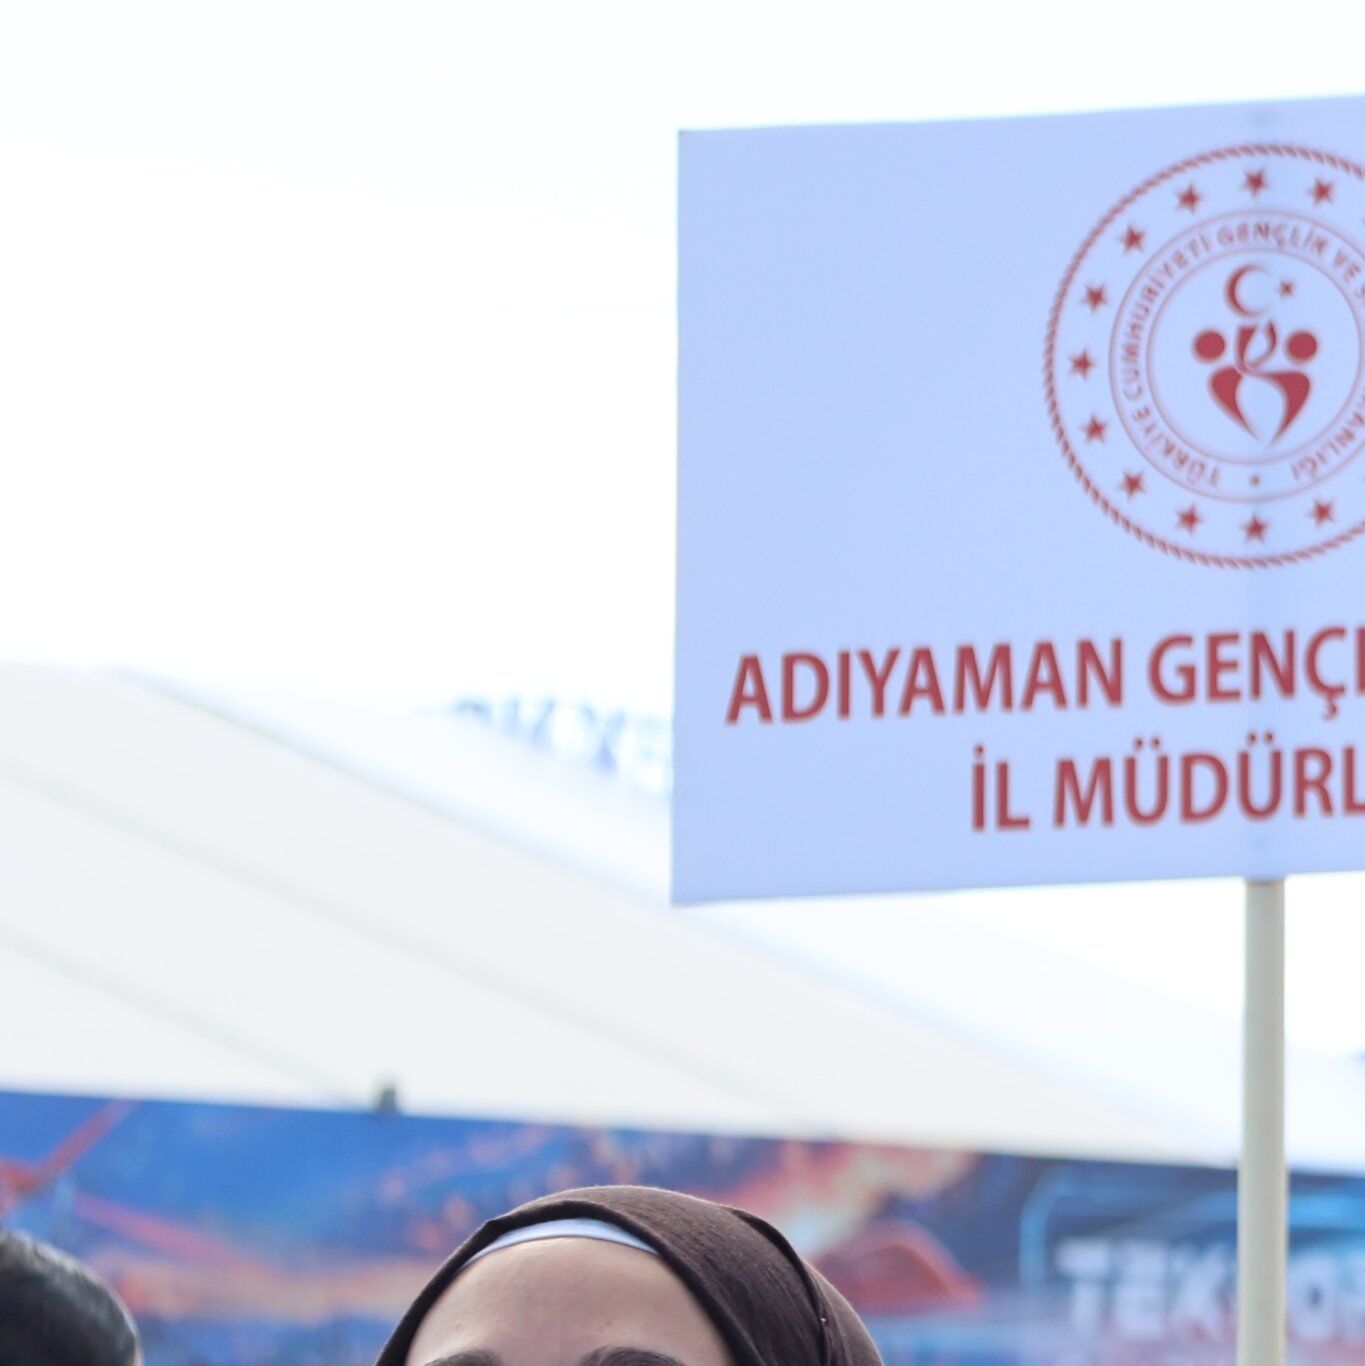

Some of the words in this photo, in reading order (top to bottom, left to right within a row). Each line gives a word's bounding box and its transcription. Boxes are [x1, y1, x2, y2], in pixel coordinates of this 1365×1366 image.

[1332, 248, 1362, 284] VE
[726, 637, 1125, 725] ADIYAMAN
[971, 744, 1032, 832] İL
